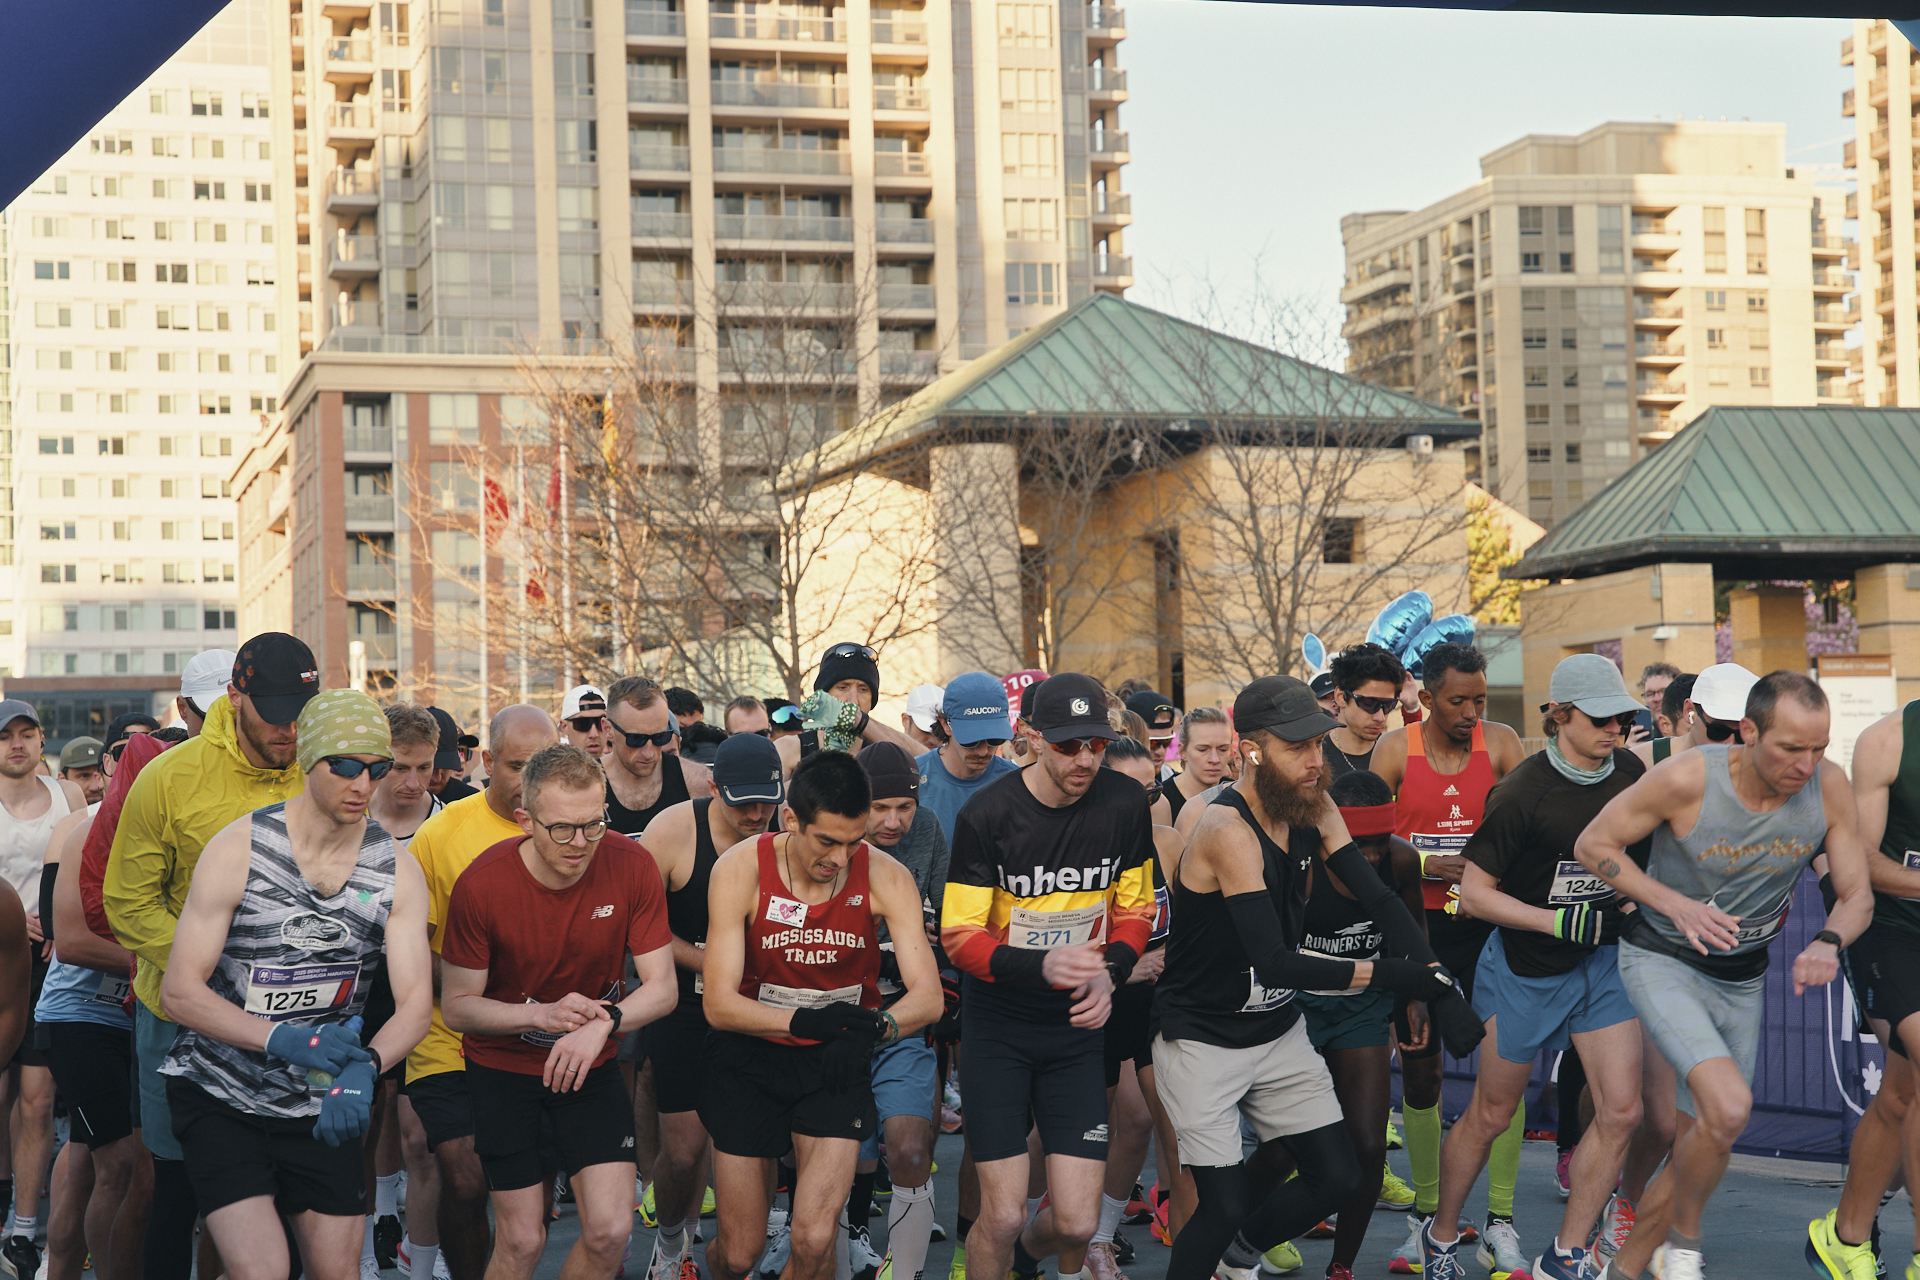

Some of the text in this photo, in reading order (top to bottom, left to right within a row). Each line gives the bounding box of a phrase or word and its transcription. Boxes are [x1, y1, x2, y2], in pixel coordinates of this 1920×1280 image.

[1566, 880, 1606, 893] 1242
[761, 928, 866, 949] MISSISSAUGA
[1026, 930, 1071, 946] 2171
[1305, 933, 1365, 954] RUNNERS'
[785, 948, 838, 965] TRACK
[264, 989, 318, 1011] 1275
